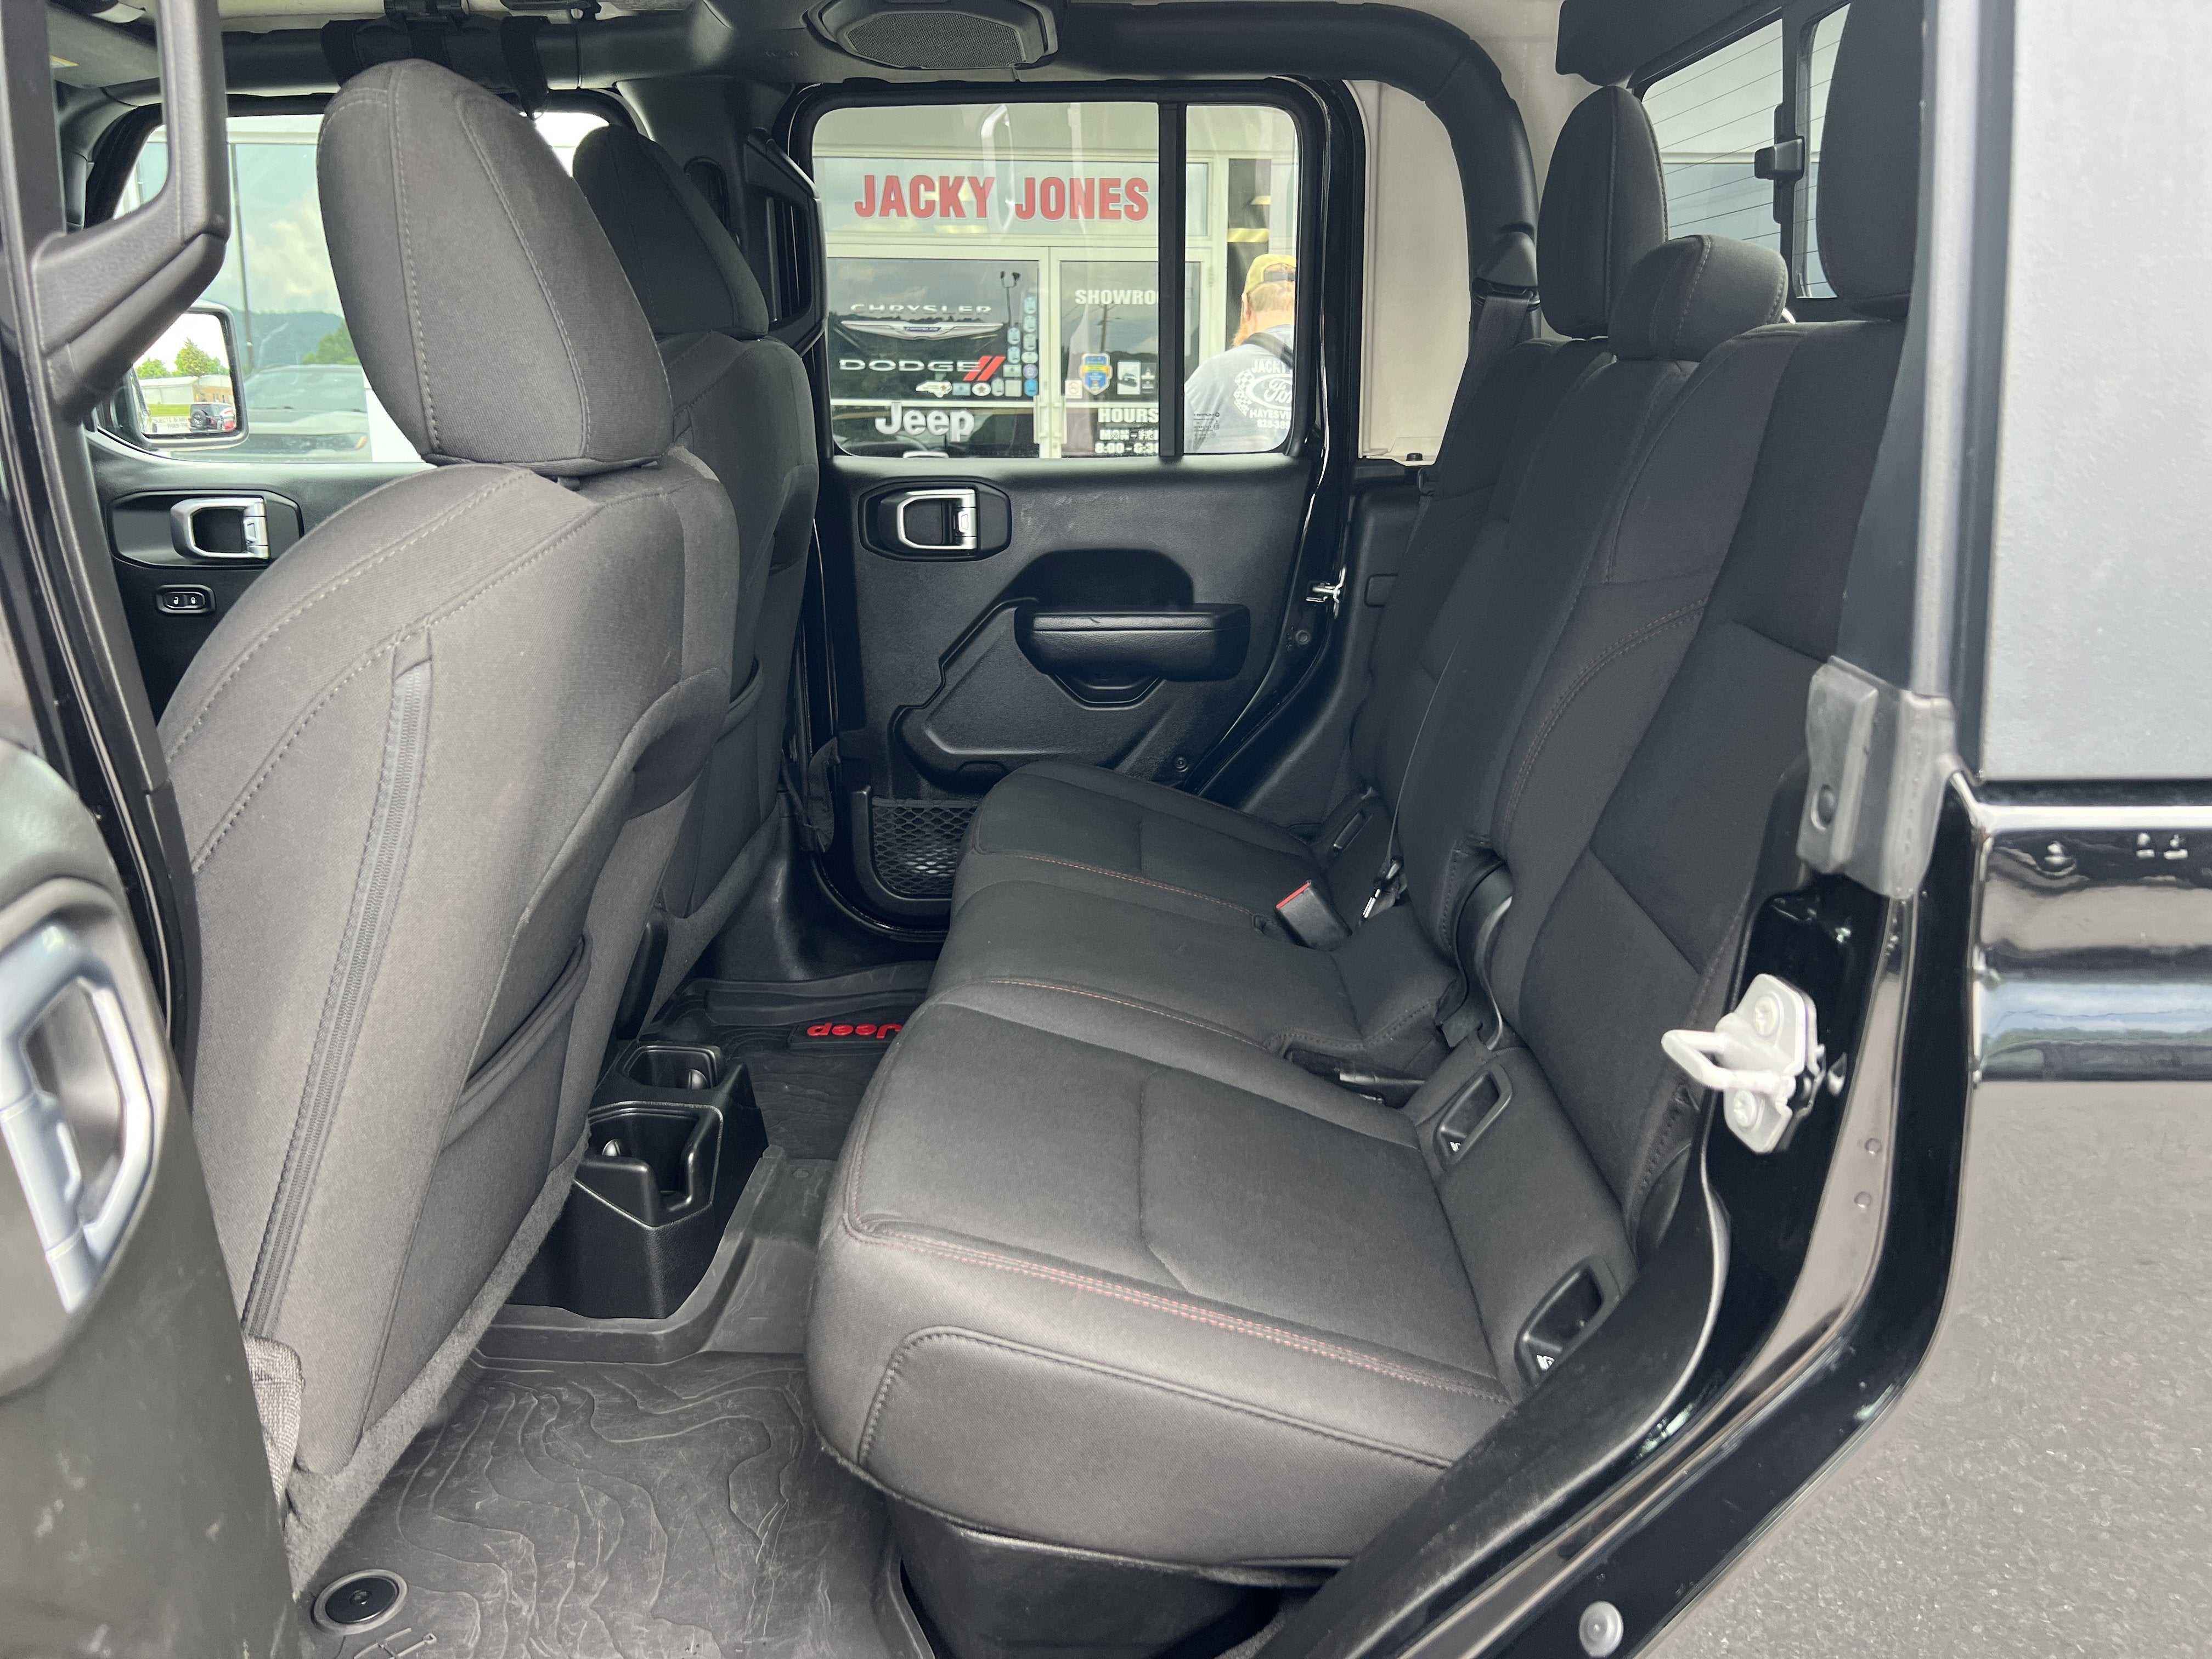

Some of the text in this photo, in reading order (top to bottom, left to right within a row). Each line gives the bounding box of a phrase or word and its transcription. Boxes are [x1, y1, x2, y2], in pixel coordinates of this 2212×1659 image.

[854, 174, 1149, 221] JACKY JONES
[1075, 289, 1159, 305] SHOWRO
[850, 303, 992, 313] CHRYSLER
[839, 359, 982, 371] DODGE
[875, 402, 974, 442] Jeep
[1098, 408, 1159, 423] HOURS
[807, 1023, 903, 1038] Jeep
